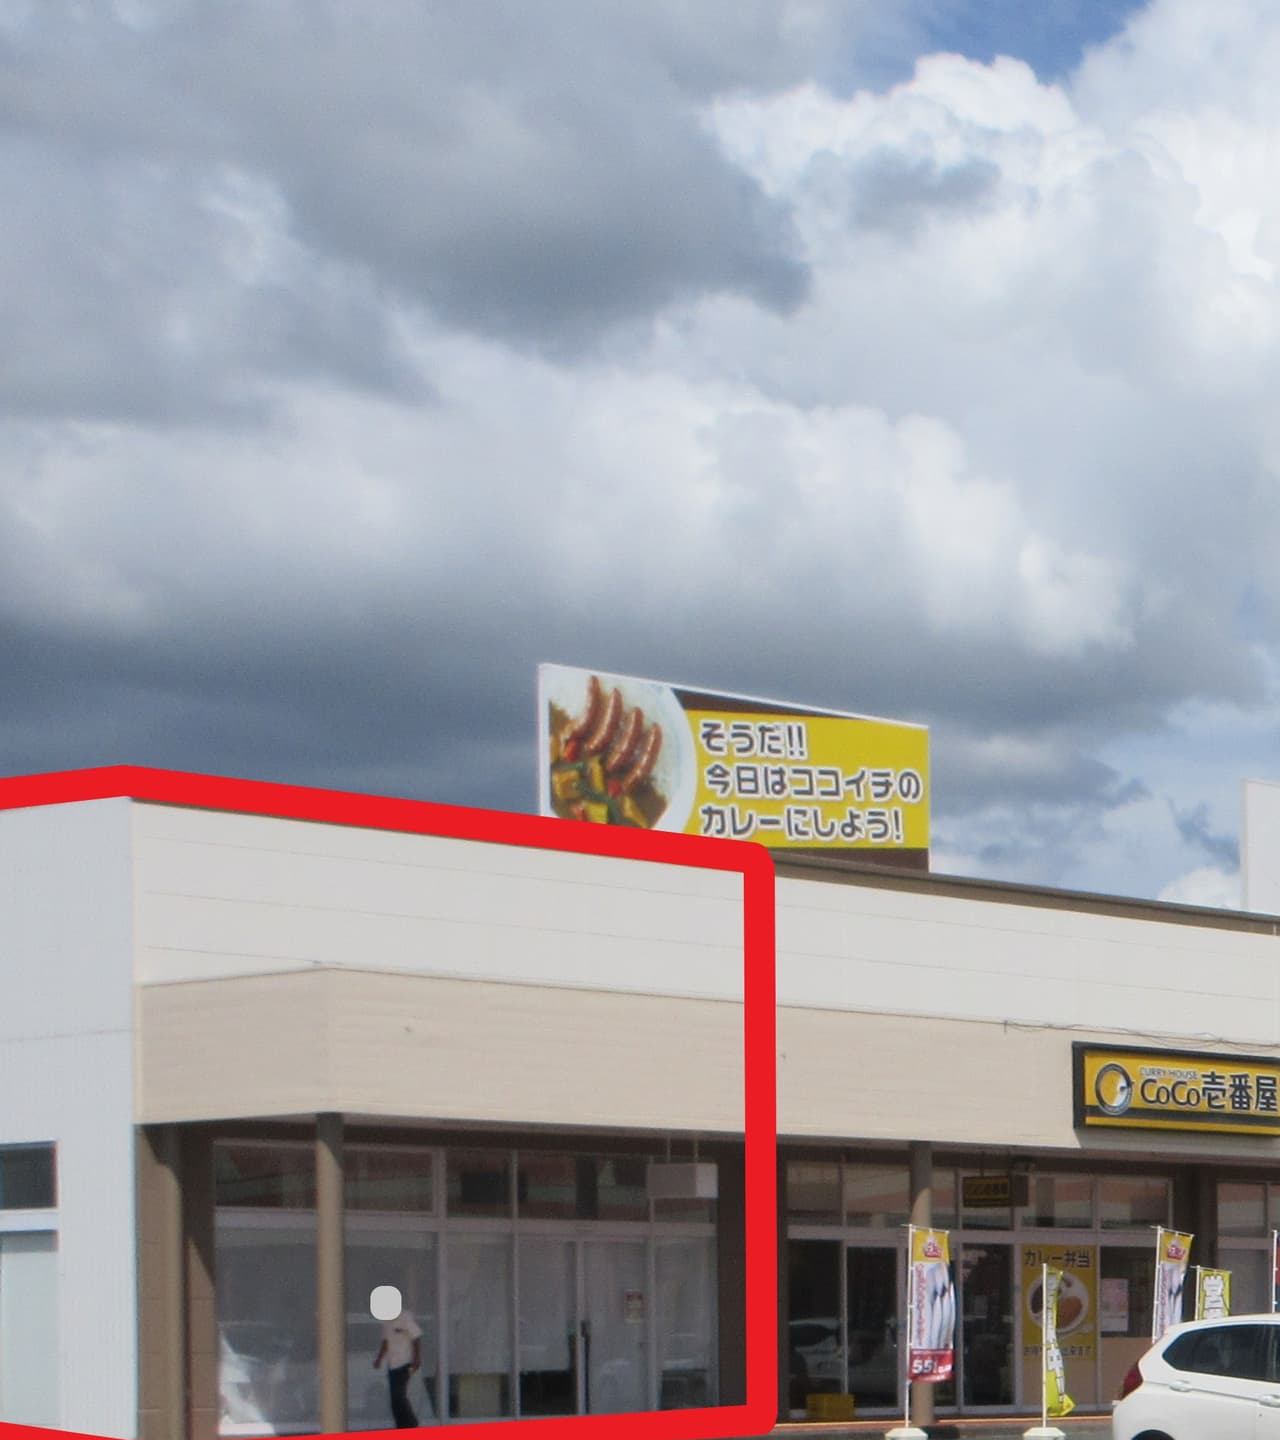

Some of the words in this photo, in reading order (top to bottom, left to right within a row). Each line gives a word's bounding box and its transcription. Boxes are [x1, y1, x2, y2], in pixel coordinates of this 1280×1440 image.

[706, 763, 921, 799] 今日はココイチの
[701, 805, 901, 840] カレーにしよう!
[1140, 1066, 1166, 1077] CURRY
[1167, 1068, 1198, 1080] HOUSE
[1140, 1071, 1278, 1111] CoCo壱番屋
[1024, 1251, 1090, 1268] カレー弁当
